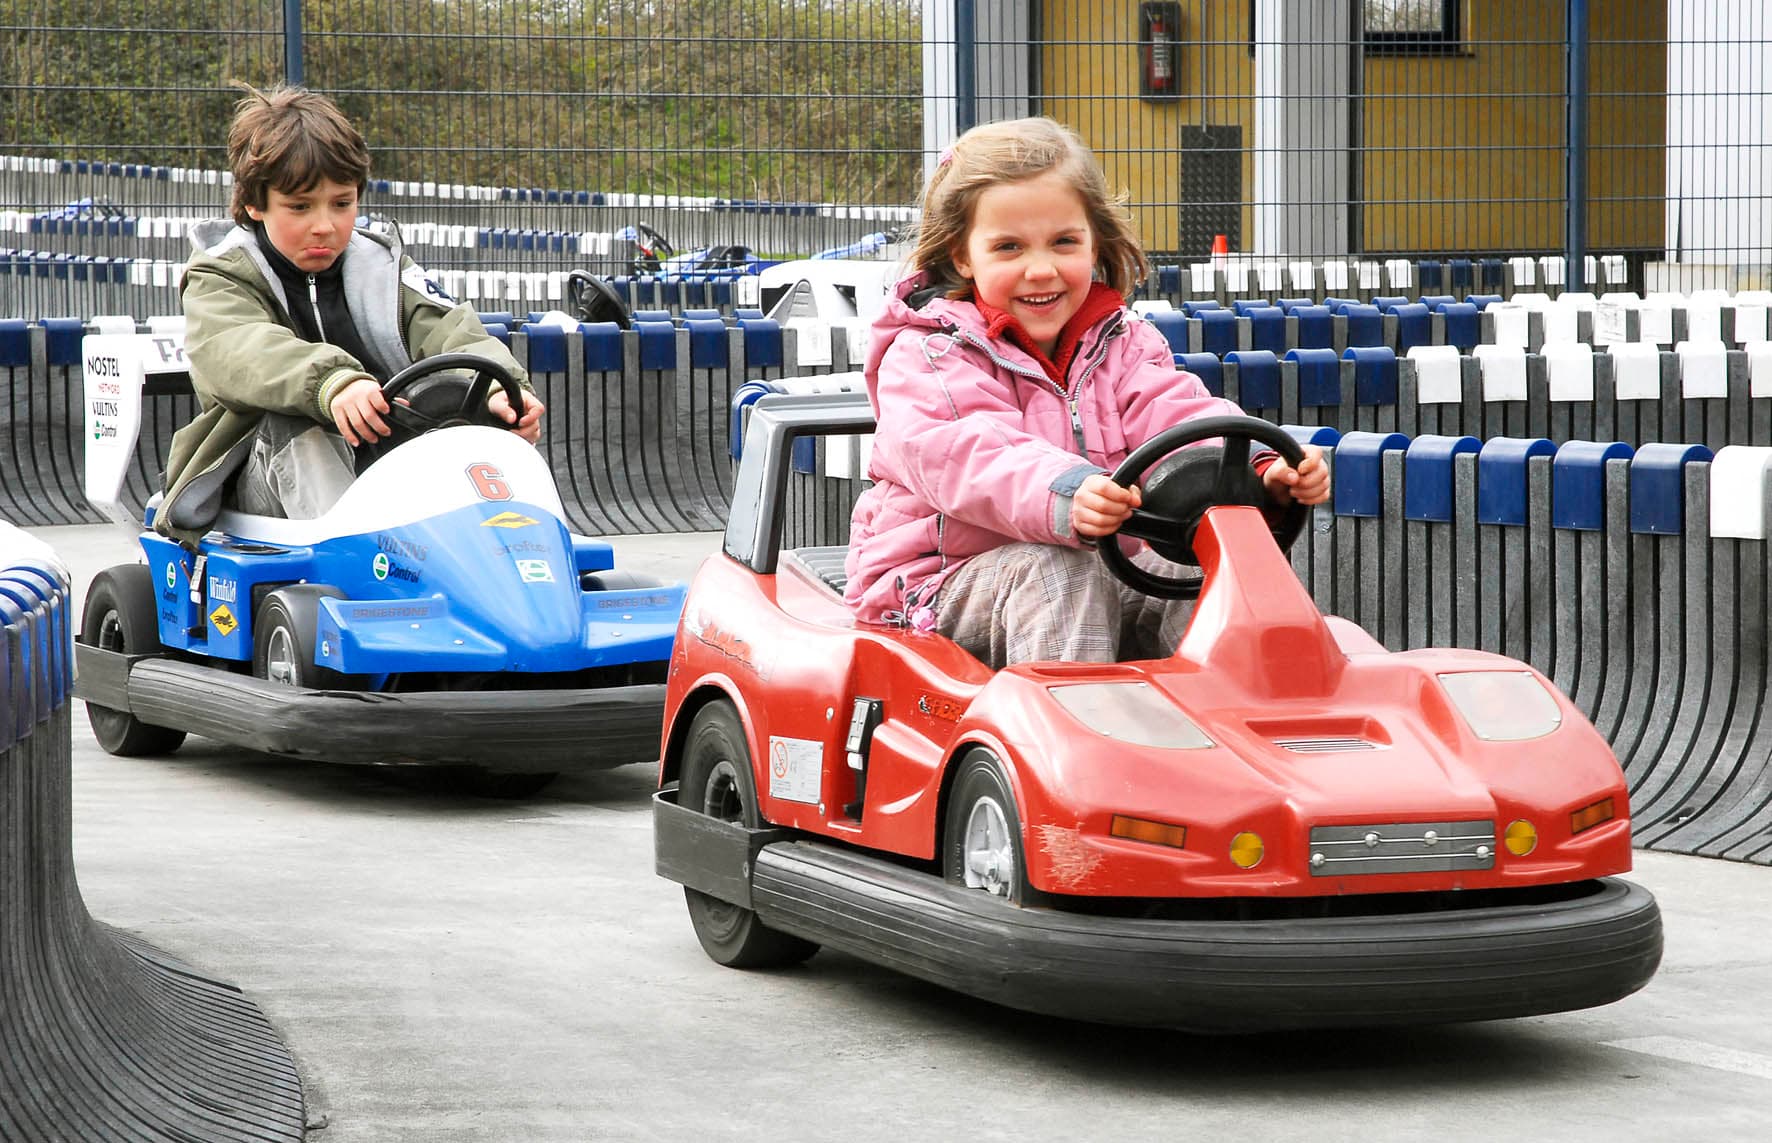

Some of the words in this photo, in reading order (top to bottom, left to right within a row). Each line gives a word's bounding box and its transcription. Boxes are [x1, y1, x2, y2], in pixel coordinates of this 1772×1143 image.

[87, 356, 120, 377] NOSTEL
[92, 402, 118, 417] VULTINS
[465, 462, 514, 502] 6
[388, 562, 423, 583] Control
